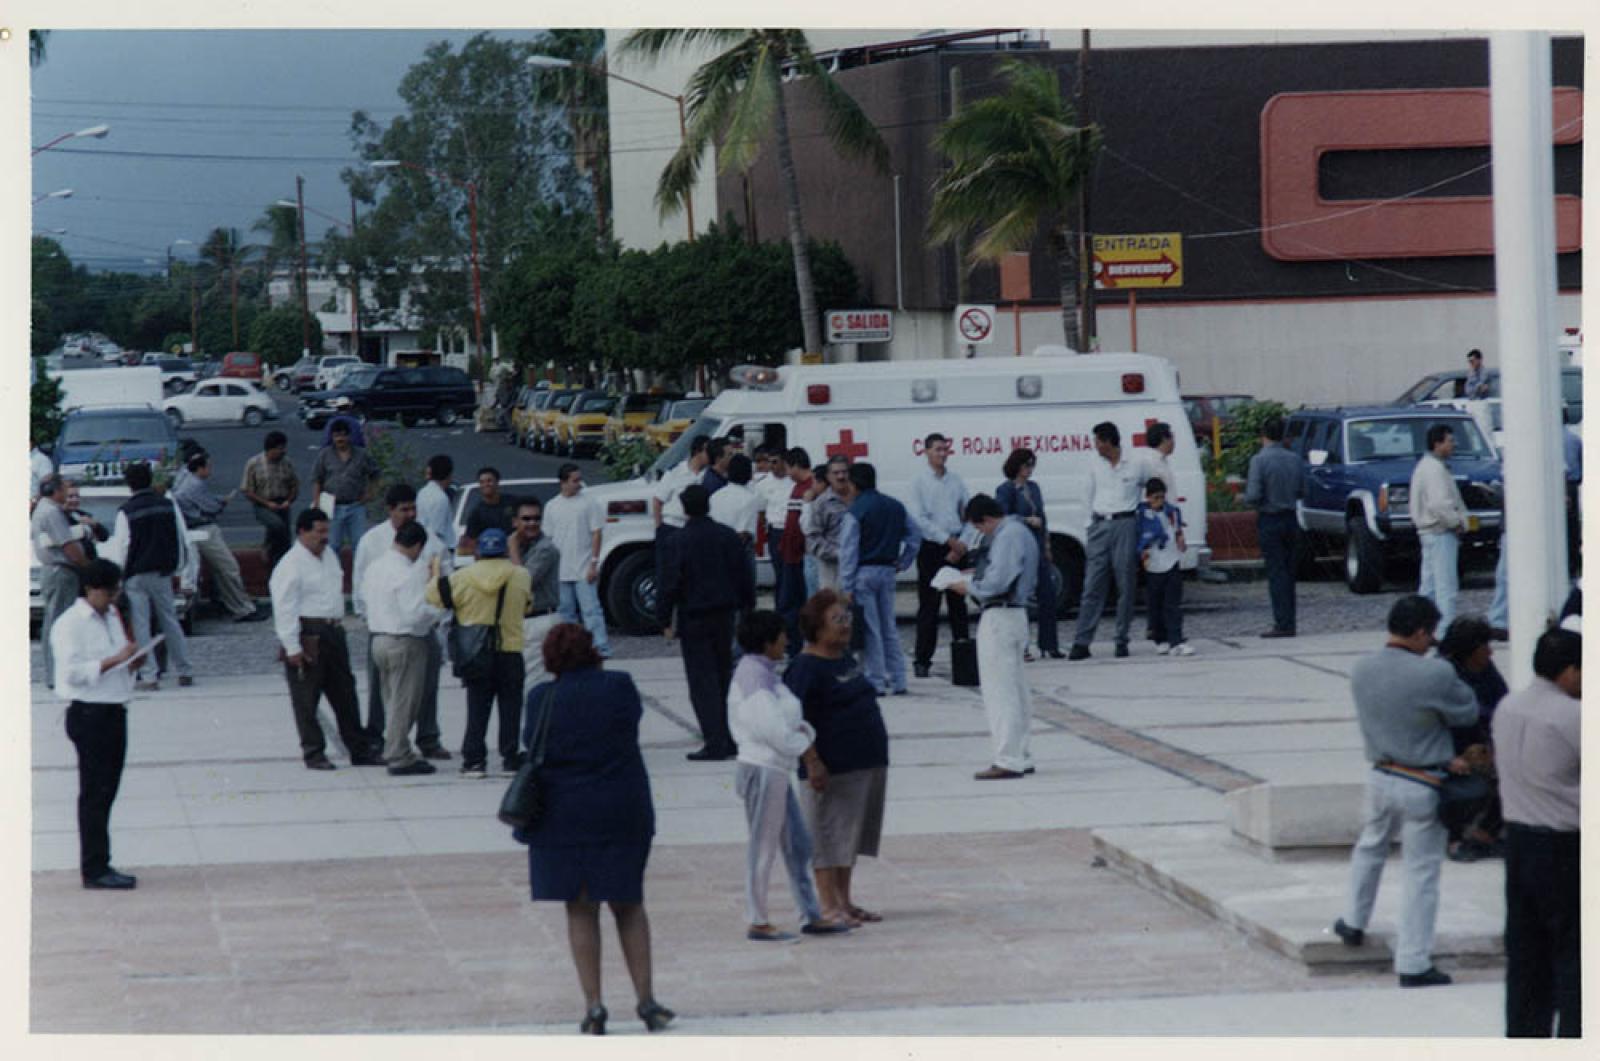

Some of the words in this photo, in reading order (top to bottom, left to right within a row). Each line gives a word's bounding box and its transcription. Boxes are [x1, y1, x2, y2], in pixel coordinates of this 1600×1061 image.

[1093, 237, 1171, 252] ENTRADA
[847, 313, 889, 330] SALIDA
[912, 437, 955, 456] CZ
[962, 437, 1003, 455] ROJA
[1011, 434, 1092, 453] MEXICANA
